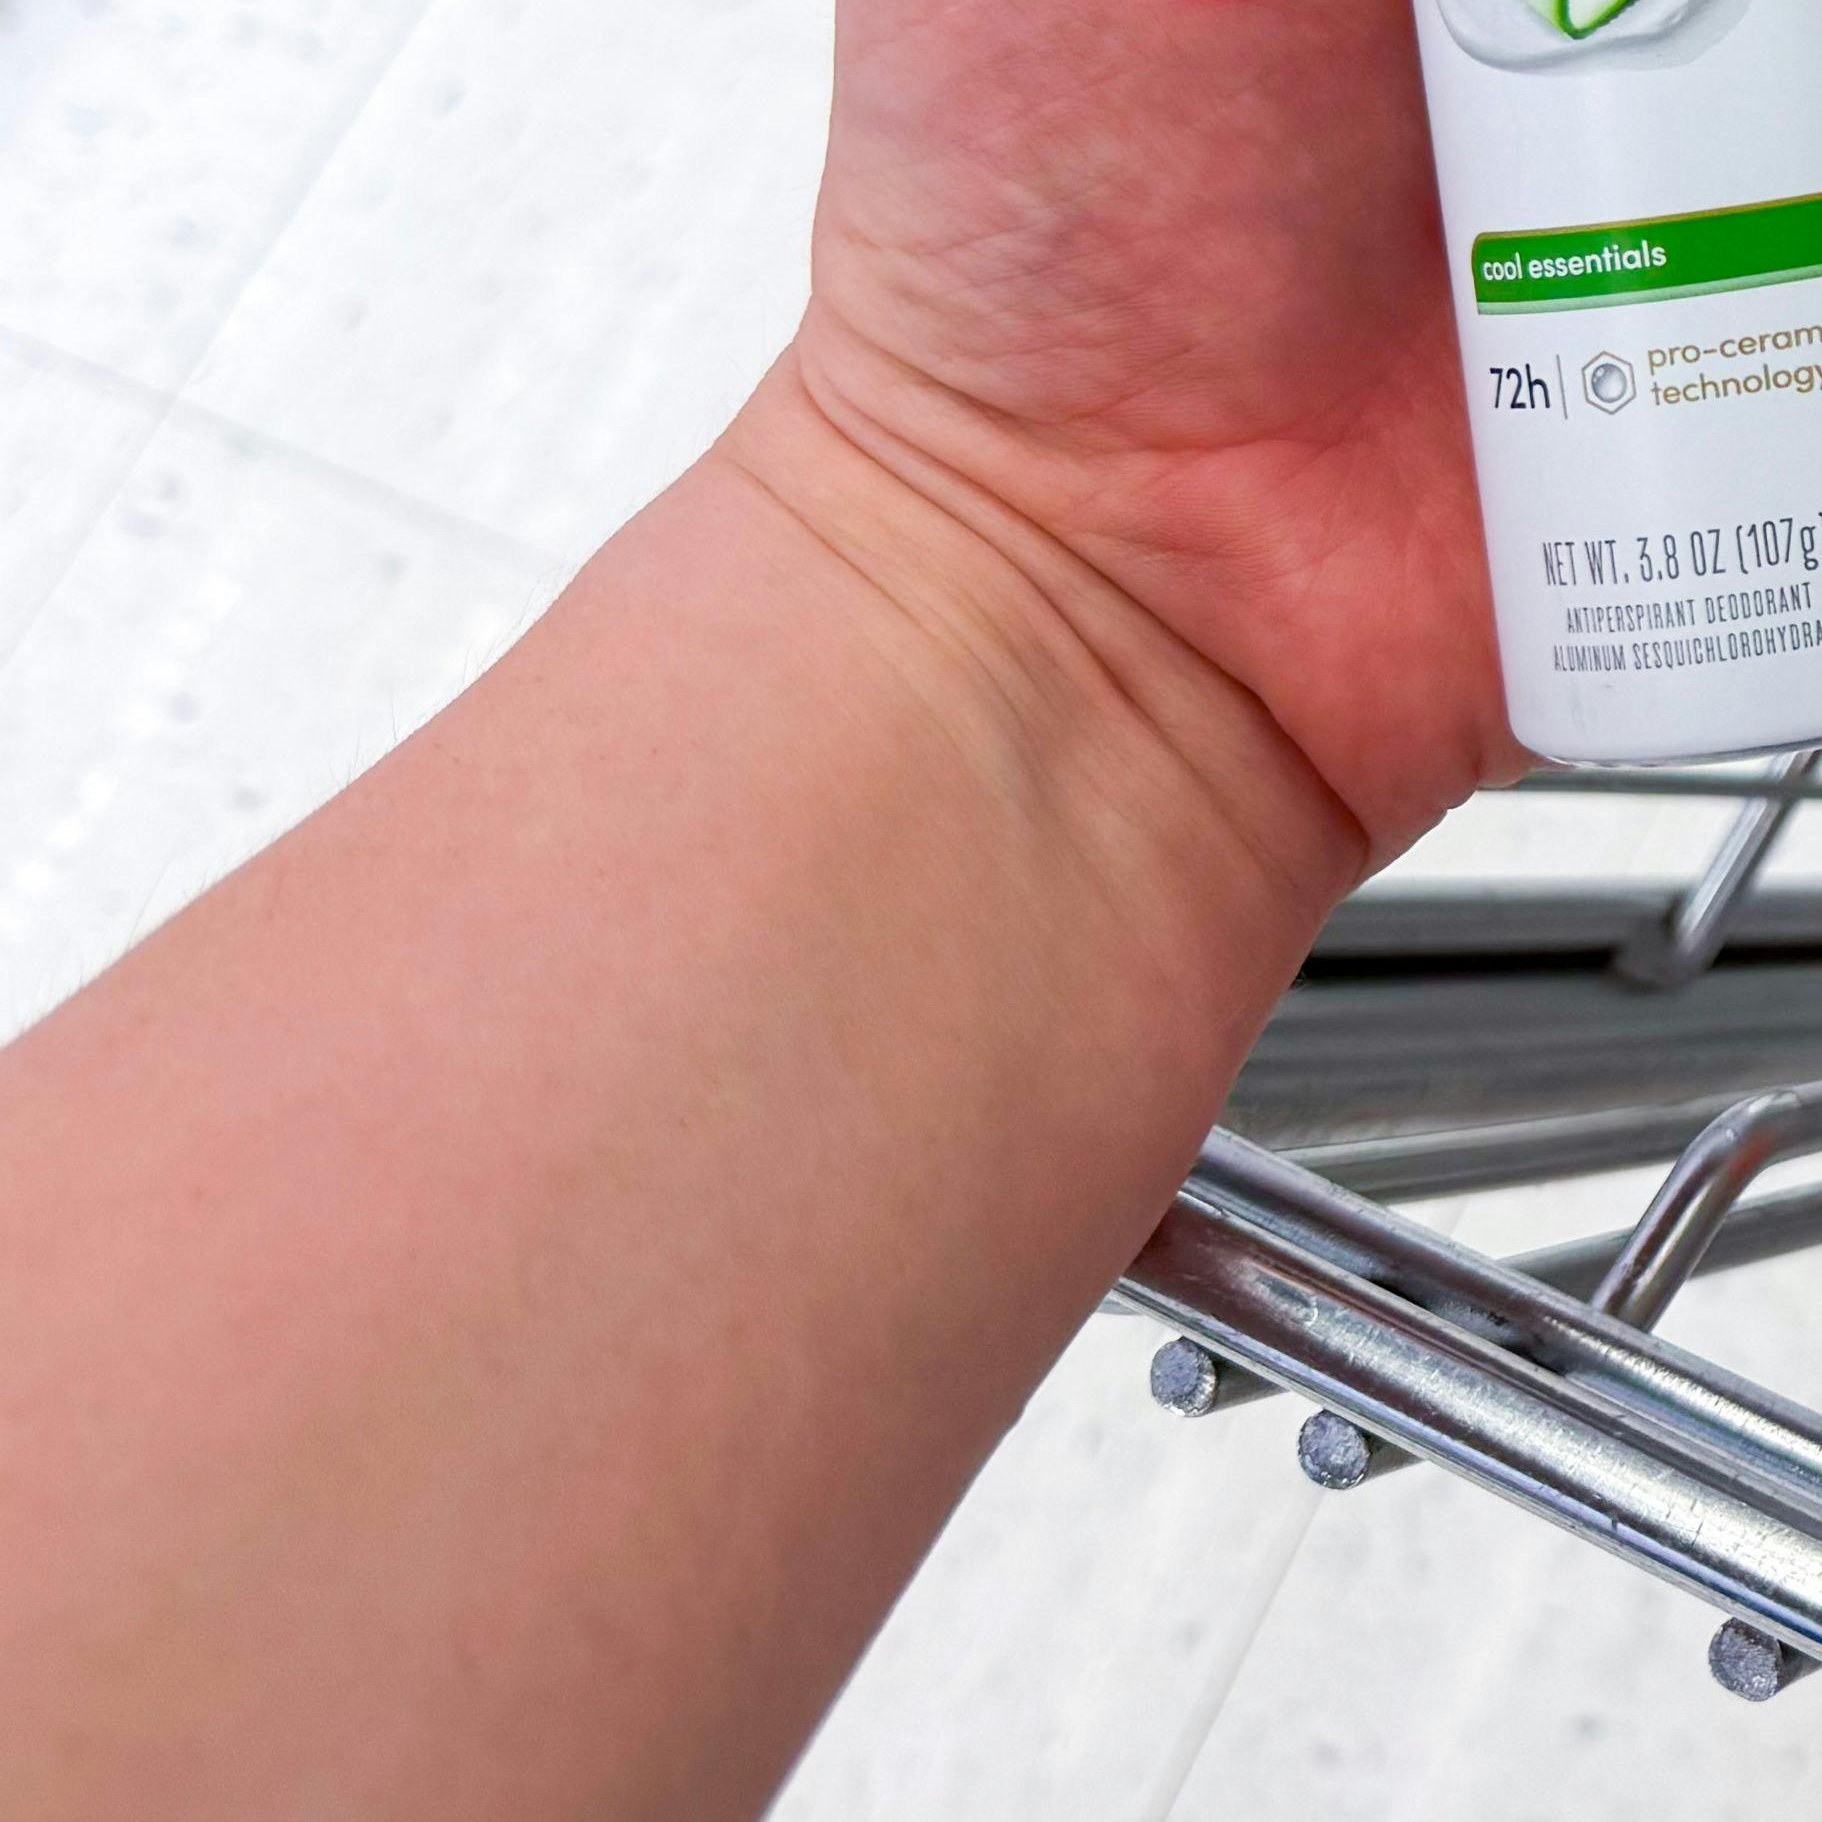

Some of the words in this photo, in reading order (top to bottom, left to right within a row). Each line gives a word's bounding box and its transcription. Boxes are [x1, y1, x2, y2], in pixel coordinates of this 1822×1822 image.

[1483, 252, 1523, 281] cool
[1529, 240, 1668, 280] essentials
[1489, 364, 1551, 410] 72h
[1542, 541, 1577, 586] NET
[1584, 538, 1630, 585] WT.
[1637, 534, 1680, 581] 3.8
[1690, 528, 1727, 576] OZ
[1566, 598, 1697, 635] ANTIPERSPIRANT
[1705, 582, 1813, 624] DEODORANT
[1554, 643, 1626, 673] ALUMINUM
